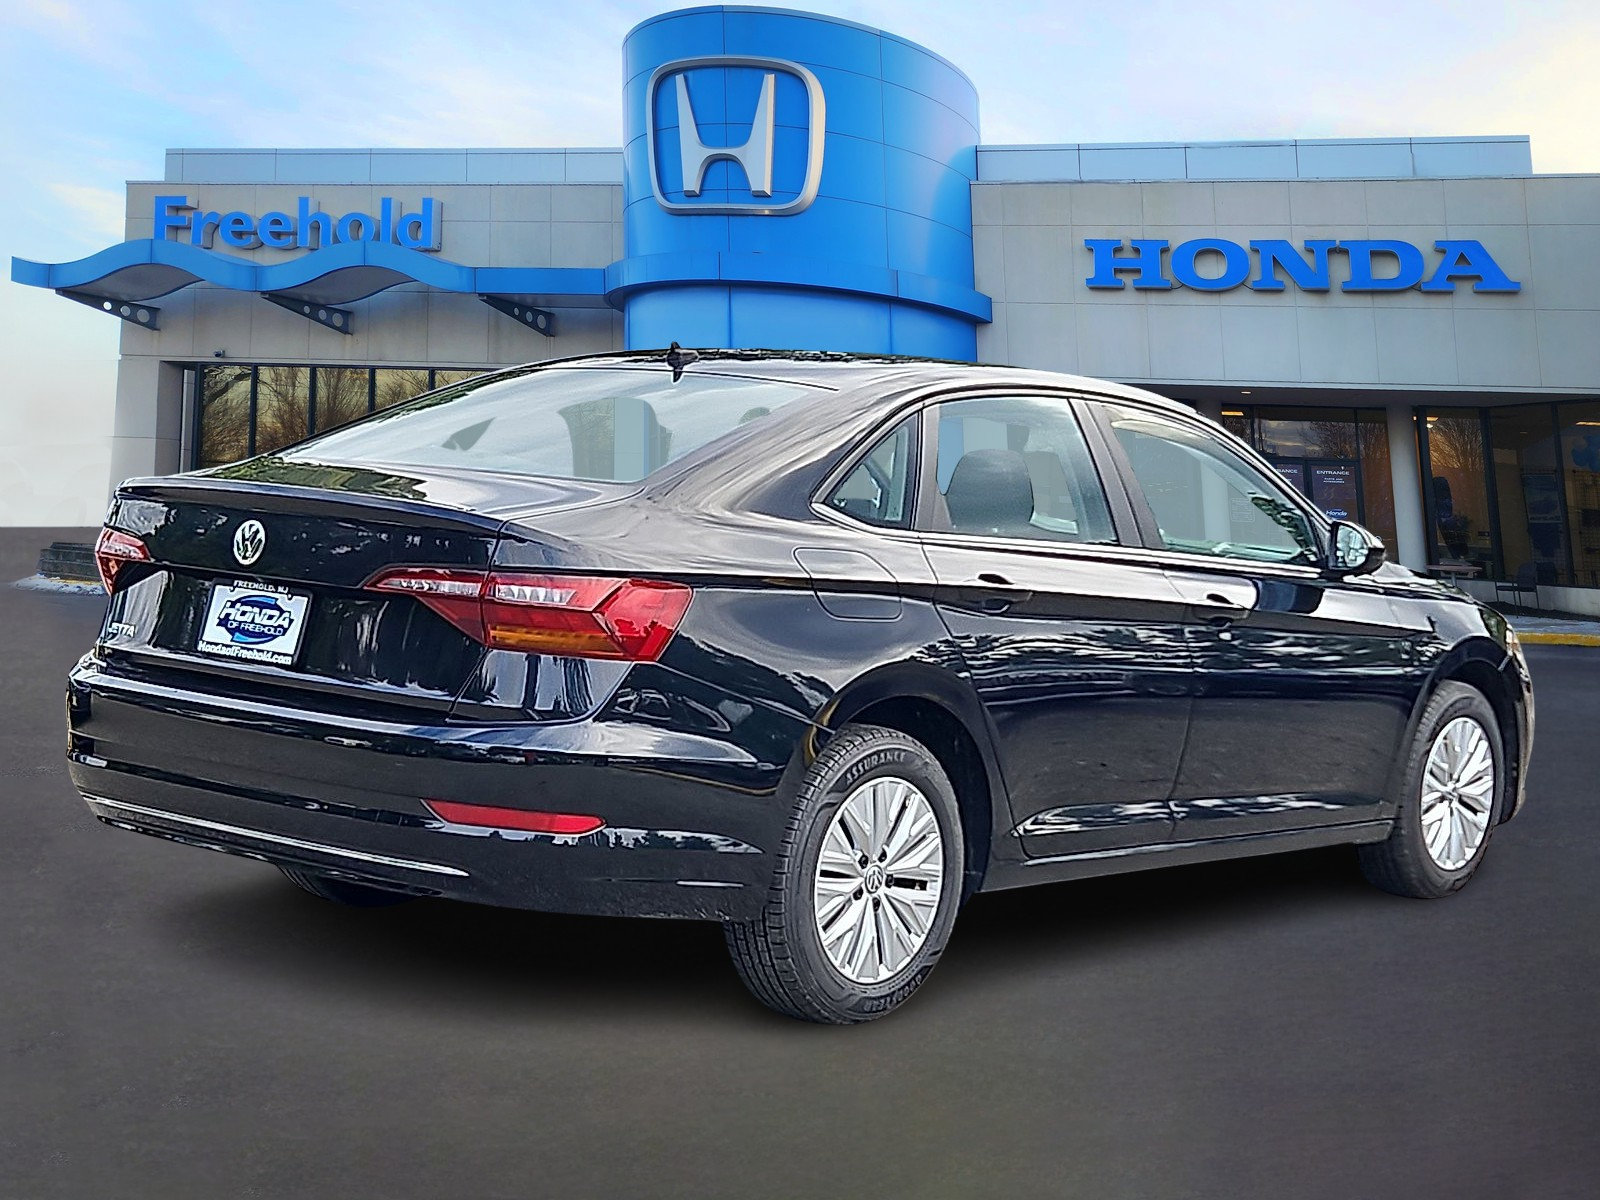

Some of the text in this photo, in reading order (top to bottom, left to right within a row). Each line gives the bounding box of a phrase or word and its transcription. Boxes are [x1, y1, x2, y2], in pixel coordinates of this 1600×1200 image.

[153, 195, 442, 251] Freehold
[1084, 238, 1522, 293] HONDA
[219, 601, 291, 629] HONDA
[227, 621, 284, 636] OF FREEHOLD
[845, 751, 906, 785] ASSURANCE
